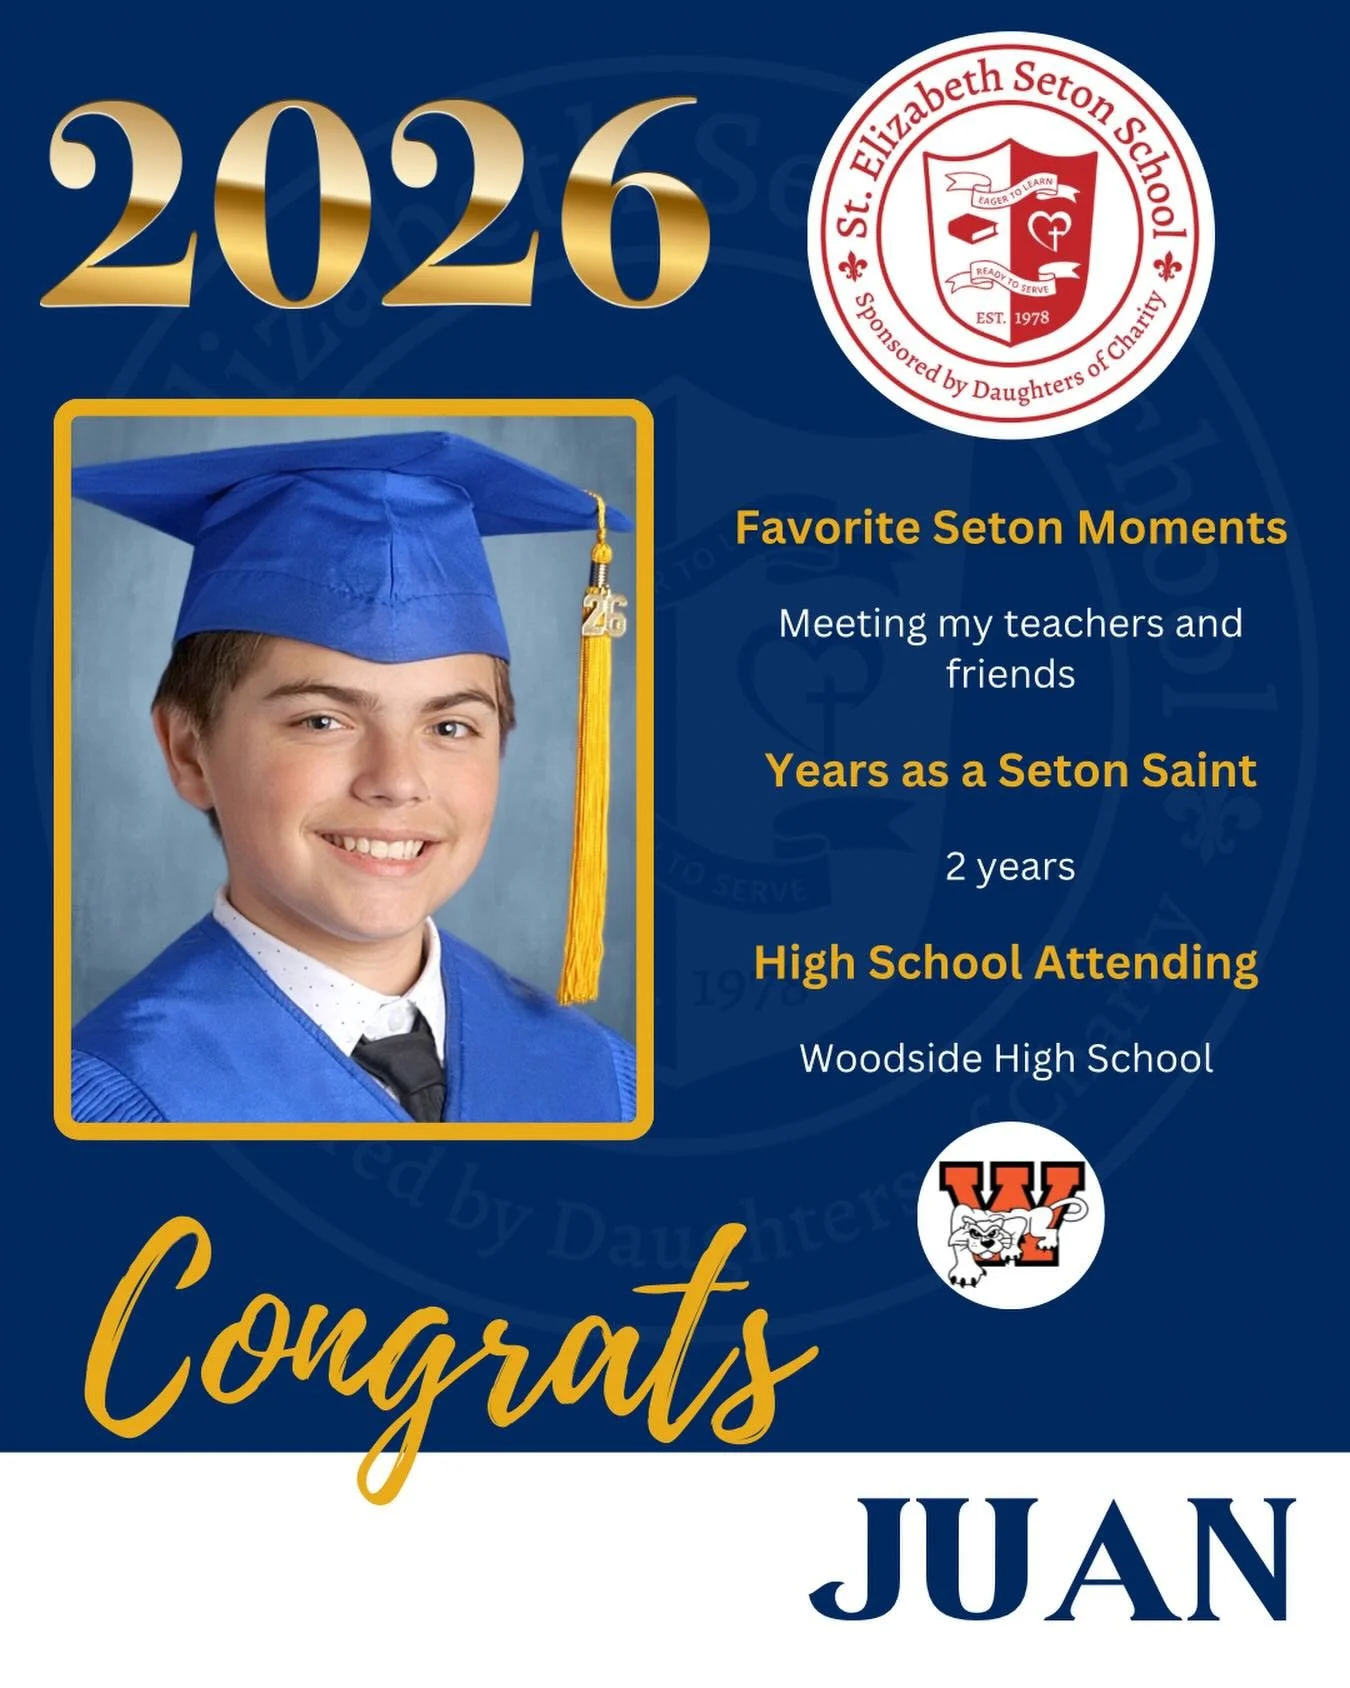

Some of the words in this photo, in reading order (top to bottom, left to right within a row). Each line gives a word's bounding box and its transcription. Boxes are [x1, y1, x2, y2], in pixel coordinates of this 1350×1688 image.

[1013, 60, 1117, 125] Seton
[850, 58, 1002, 182] Elizabeth
[978, 193, 1009, 206] EAGER
[1010, 188, 1022, 200] TO
[1022, 178, 1053, 192] LEARN
[1113, 116, 1187, 239] School
[40, 97, 711, 309] 2026
[836, 191, 873, 239] St.
[976, 268, 1006, 281] READY
[1007, 277, 1018, 289] TO
[1021, 284, 1049, 294] SERVE
[976, 311, 1006, 324] EST.
[1015, 311, 1050, 325] 1978
[855, 291, 941, 381] Sponsored
[942, 369, 968, 398] by
[972, 371, 1085, 406] Daughters
[1088, 351, 1109, 377] of
[1106, 290, 1167, 360] Charity
[738, 508, 919, 544] Favorite
[934, 510, 1062, 544] Seton
[1080, 510, 1287, 544] Moments
[582, 593, 628, 637] 26
[781, 608, 926, 645] Meeting
[940, 616, 992, 645] my
[1004, 608, 1163, 637] teachers
[1177, 608, 1241, 637] and
[946, 657, 1075, 688] friends
[765, 753, 888, 787] Years
[903, 761, 948, 787] as
[962, 761, 986, 787] a
[1000, 753, 1127, 787] Seton
[1143, 752, 1257, 787] Saint
[946, 852, 964, 880] 2
[977, 859, 1075, 889] years
[756, 944, 855, 990] High
[870, 944, 1022, 979] School
[1035, 944, 1258, 989] Attending
[800, 1043, 981, 1072] Woodside
[996, 1043, 1074, 1081] High
[1088, 1043, 1213, 1072] School
[84, 1216, 820, 1505] Congrats
[809, 1498, 1296, 1620] JUAN
